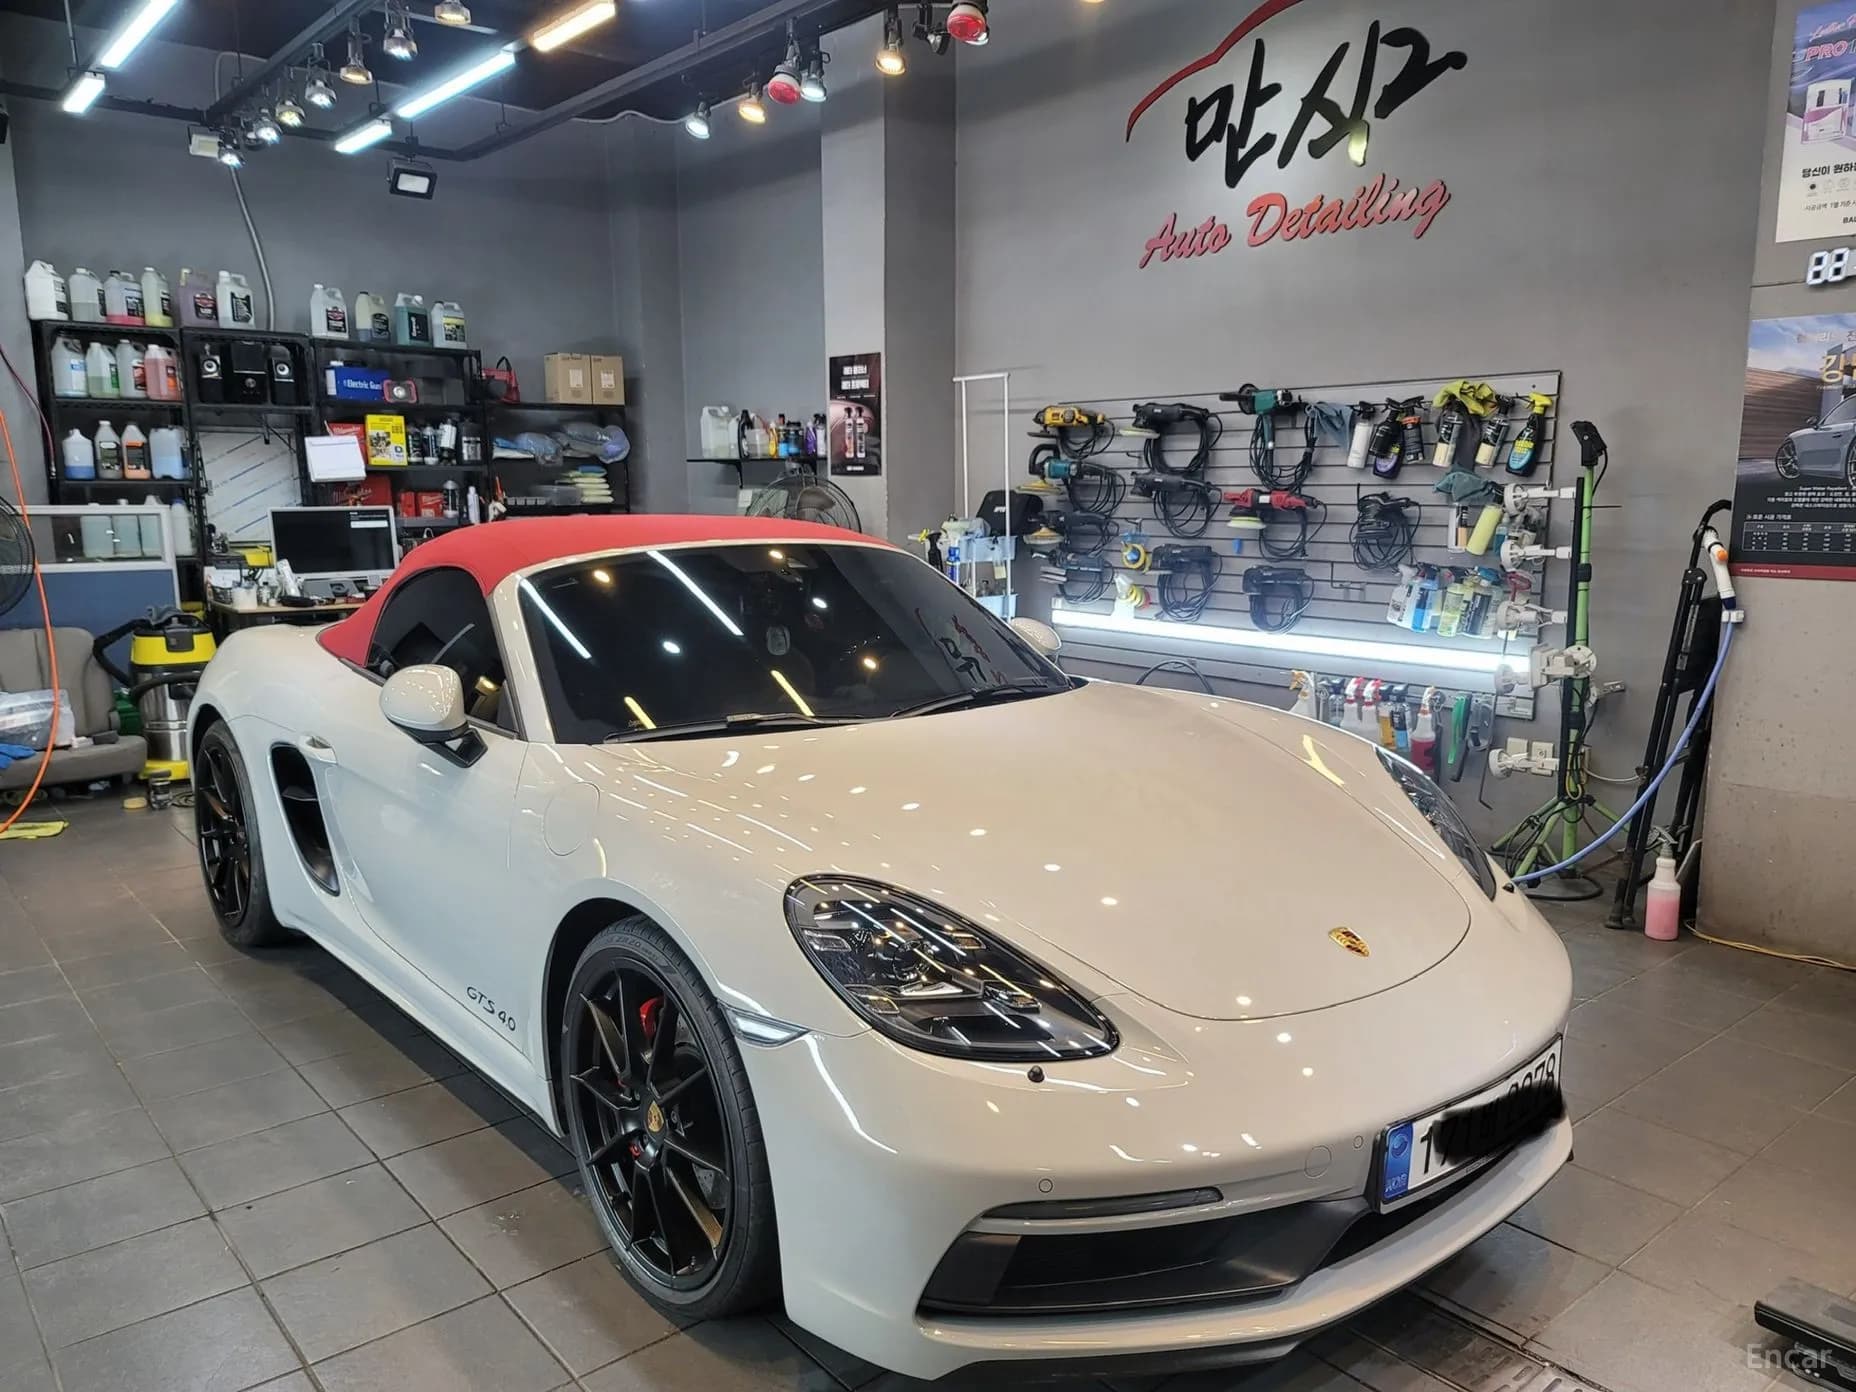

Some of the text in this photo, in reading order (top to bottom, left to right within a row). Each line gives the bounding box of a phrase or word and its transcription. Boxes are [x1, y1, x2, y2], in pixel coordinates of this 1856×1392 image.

[1802, 162, 1856, 178] 당신이 원하
[1139, 173, 1452, 269] Auto Detailing
[347, 379, 369, 390] Electric
[466, 986, 496, 1015] GTS
